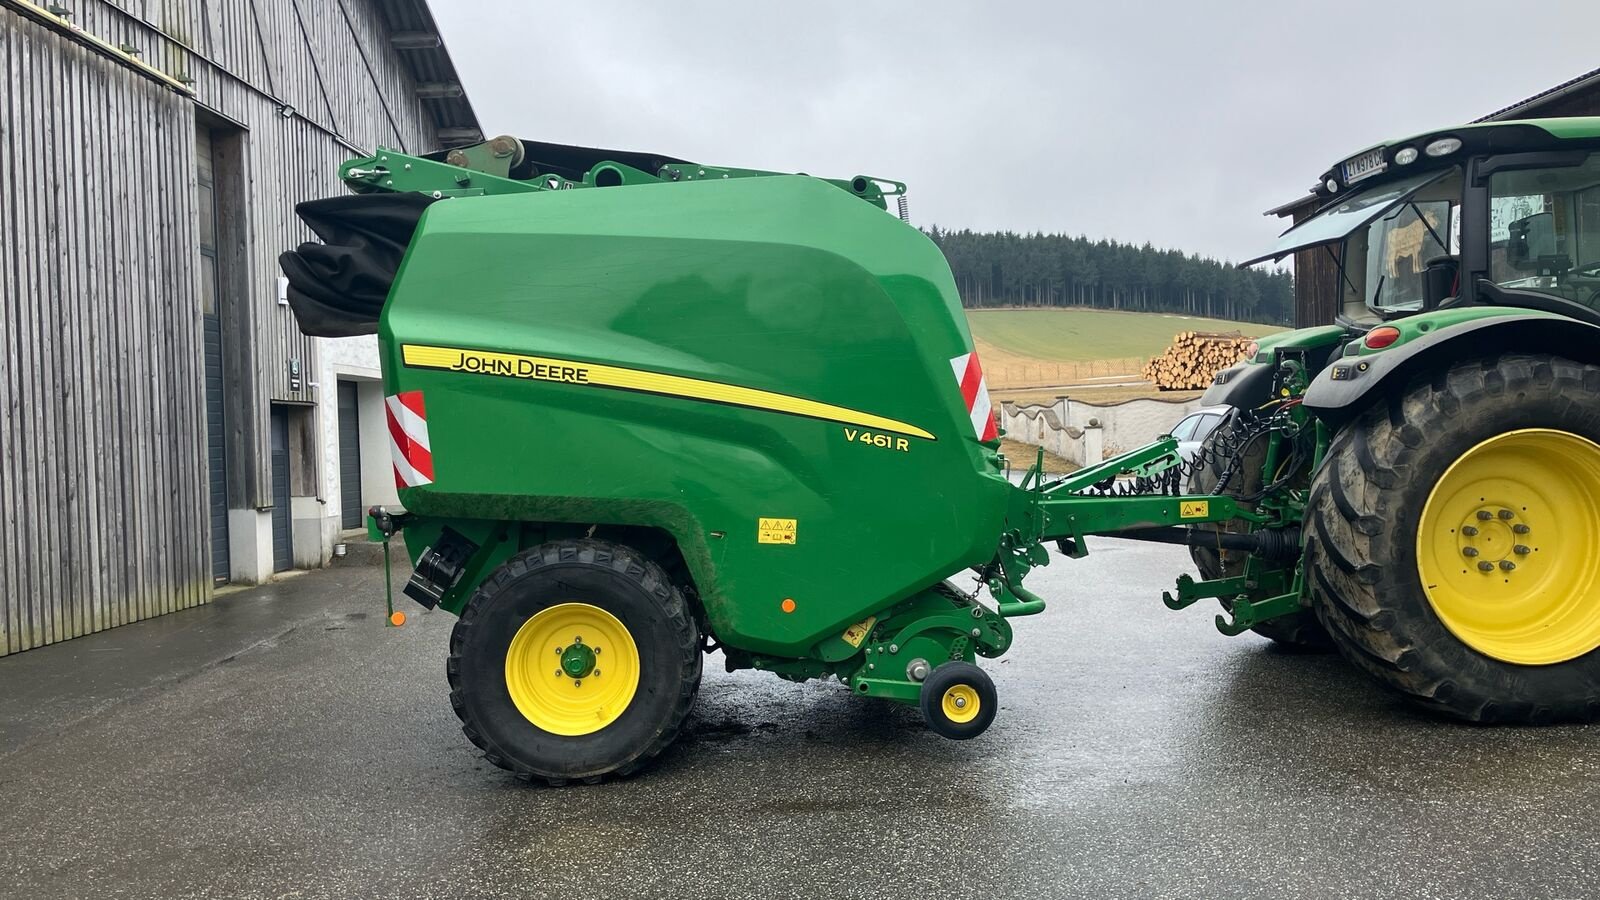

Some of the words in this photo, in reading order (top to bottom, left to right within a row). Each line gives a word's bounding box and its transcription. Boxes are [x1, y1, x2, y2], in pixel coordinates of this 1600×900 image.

[1361, 154, 1374, 172] 978
[452, 353, 512, 374] JOHN
[517, 359, 589, 382] DEERE
[844, 428, 858, 442] V
[859, 432, 892, 449] 461
[896, 437, 909, 452] R
